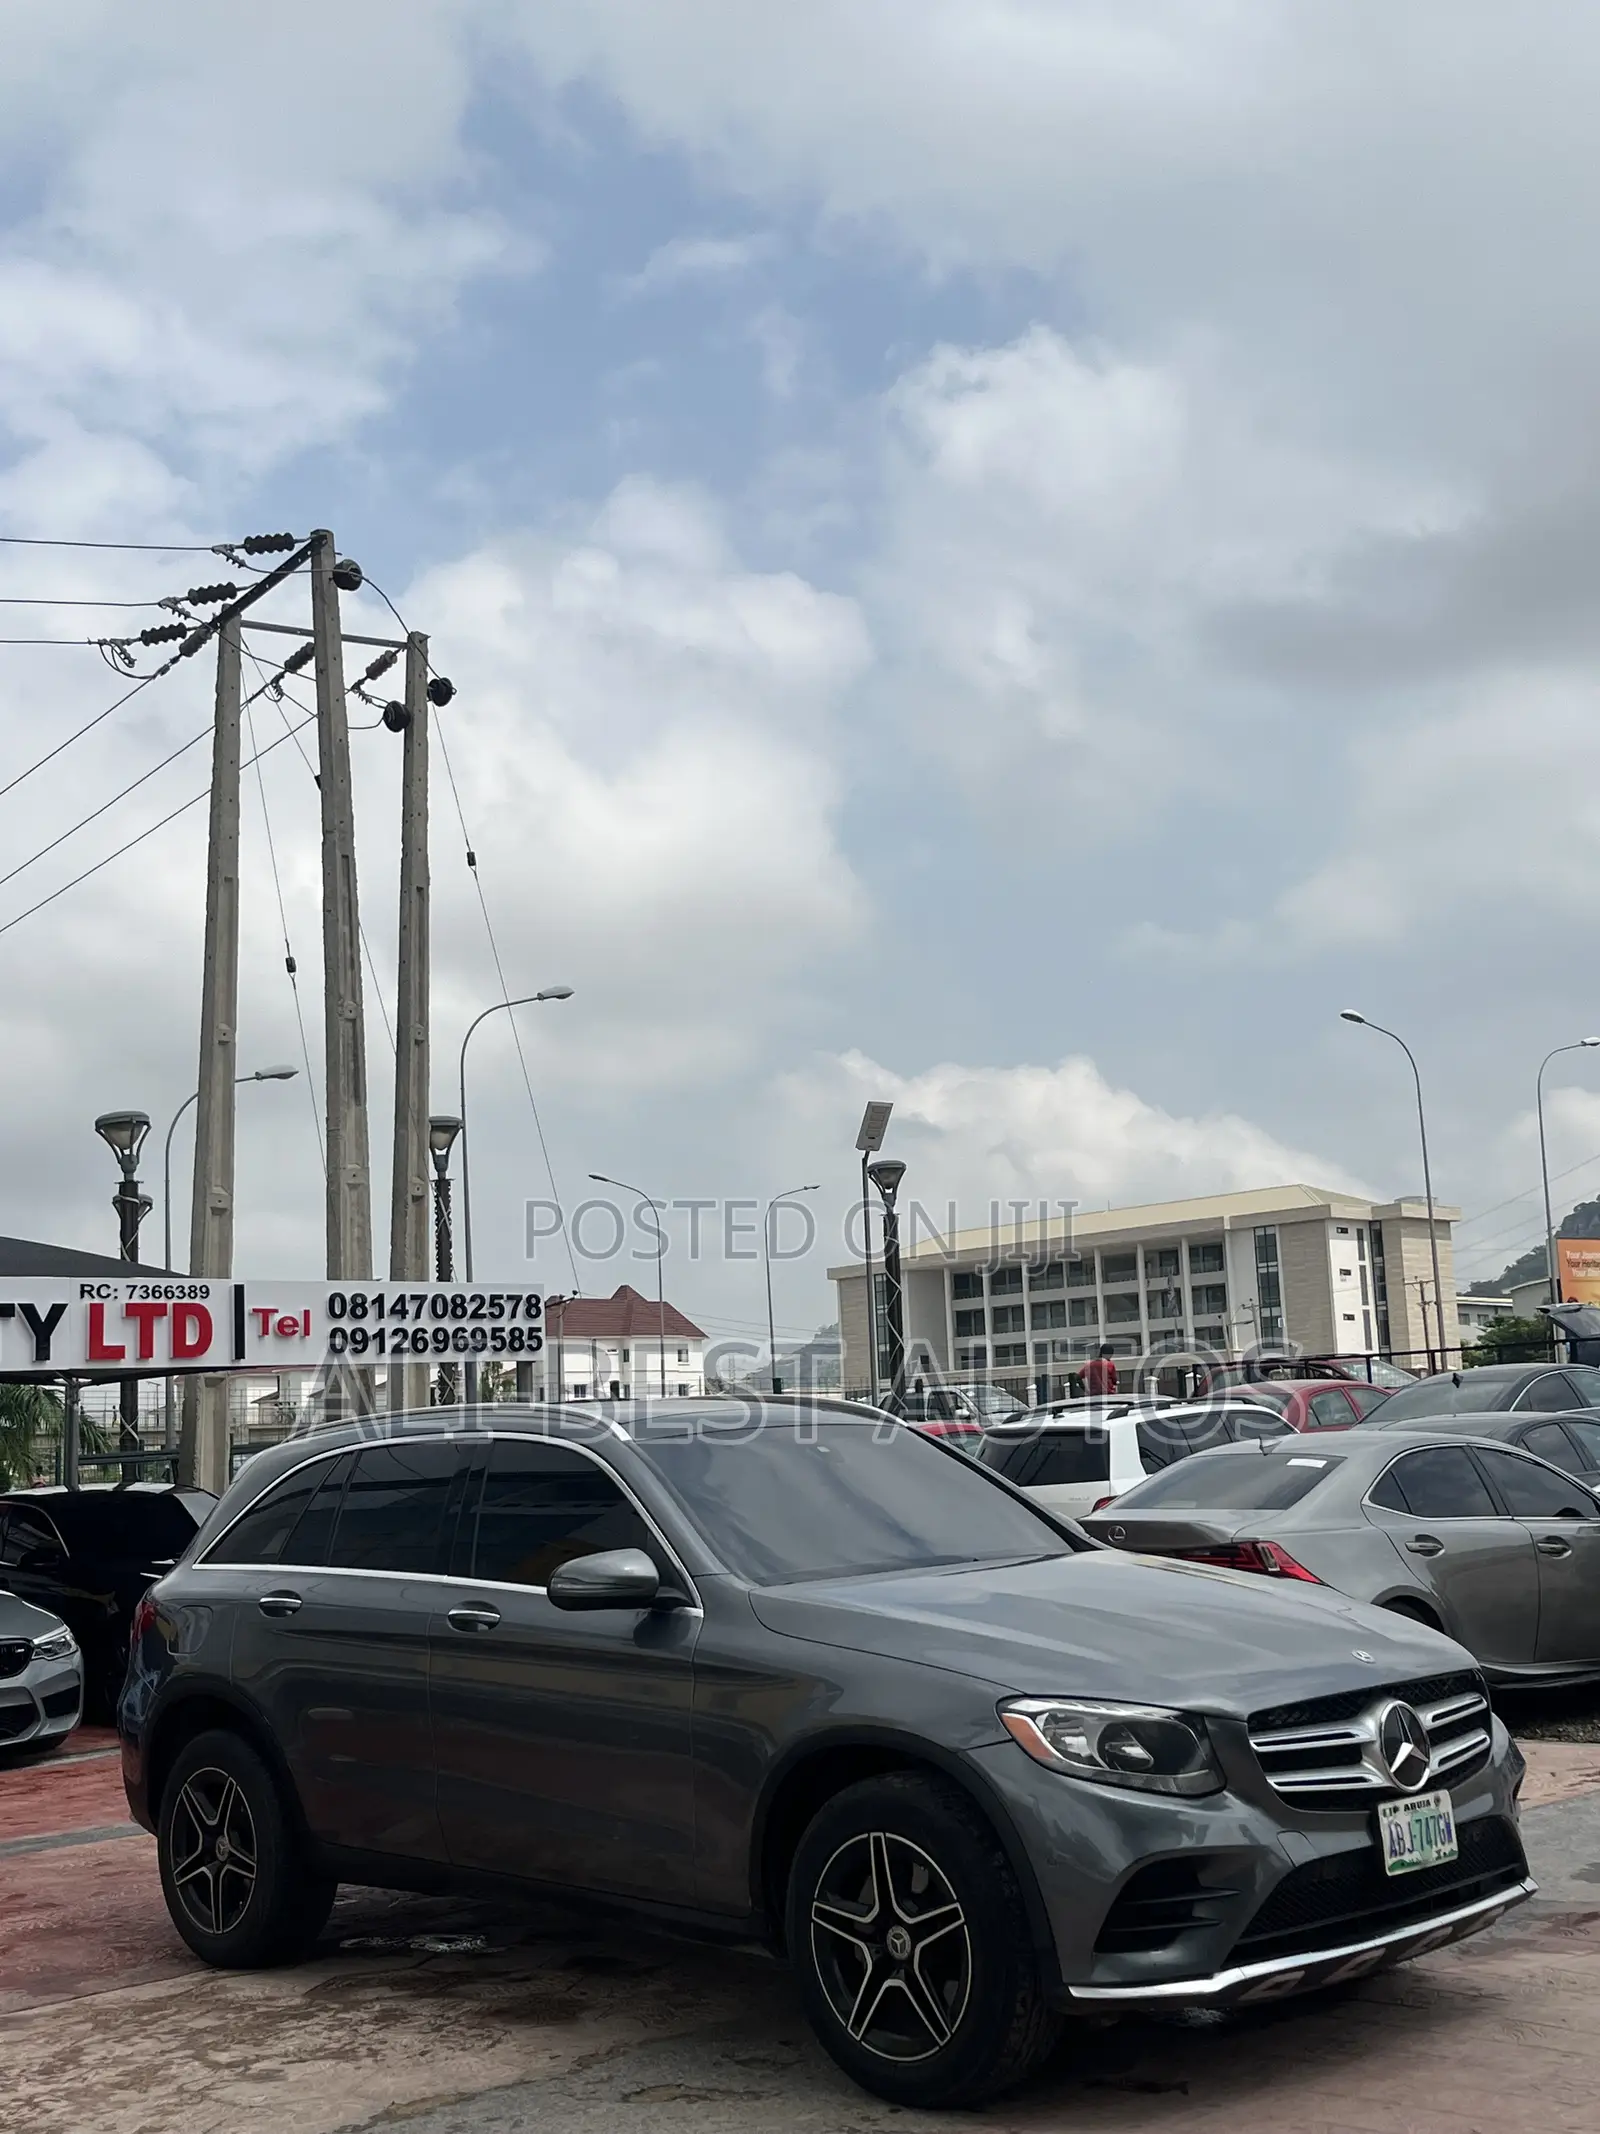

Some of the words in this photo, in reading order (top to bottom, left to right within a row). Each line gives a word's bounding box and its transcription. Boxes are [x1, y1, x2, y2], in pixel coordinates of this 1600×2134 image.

[79, 1284, 119, 1300] RC:
[126, 1284, 211, 1300] 7366389
[327, 1292, 543, 1320] 08147082578
[87, 1302, 214, 1361] LTD
[251, 1307, 311, 1337] Tel
[328, 1326, 543, 1355] 09126969585
